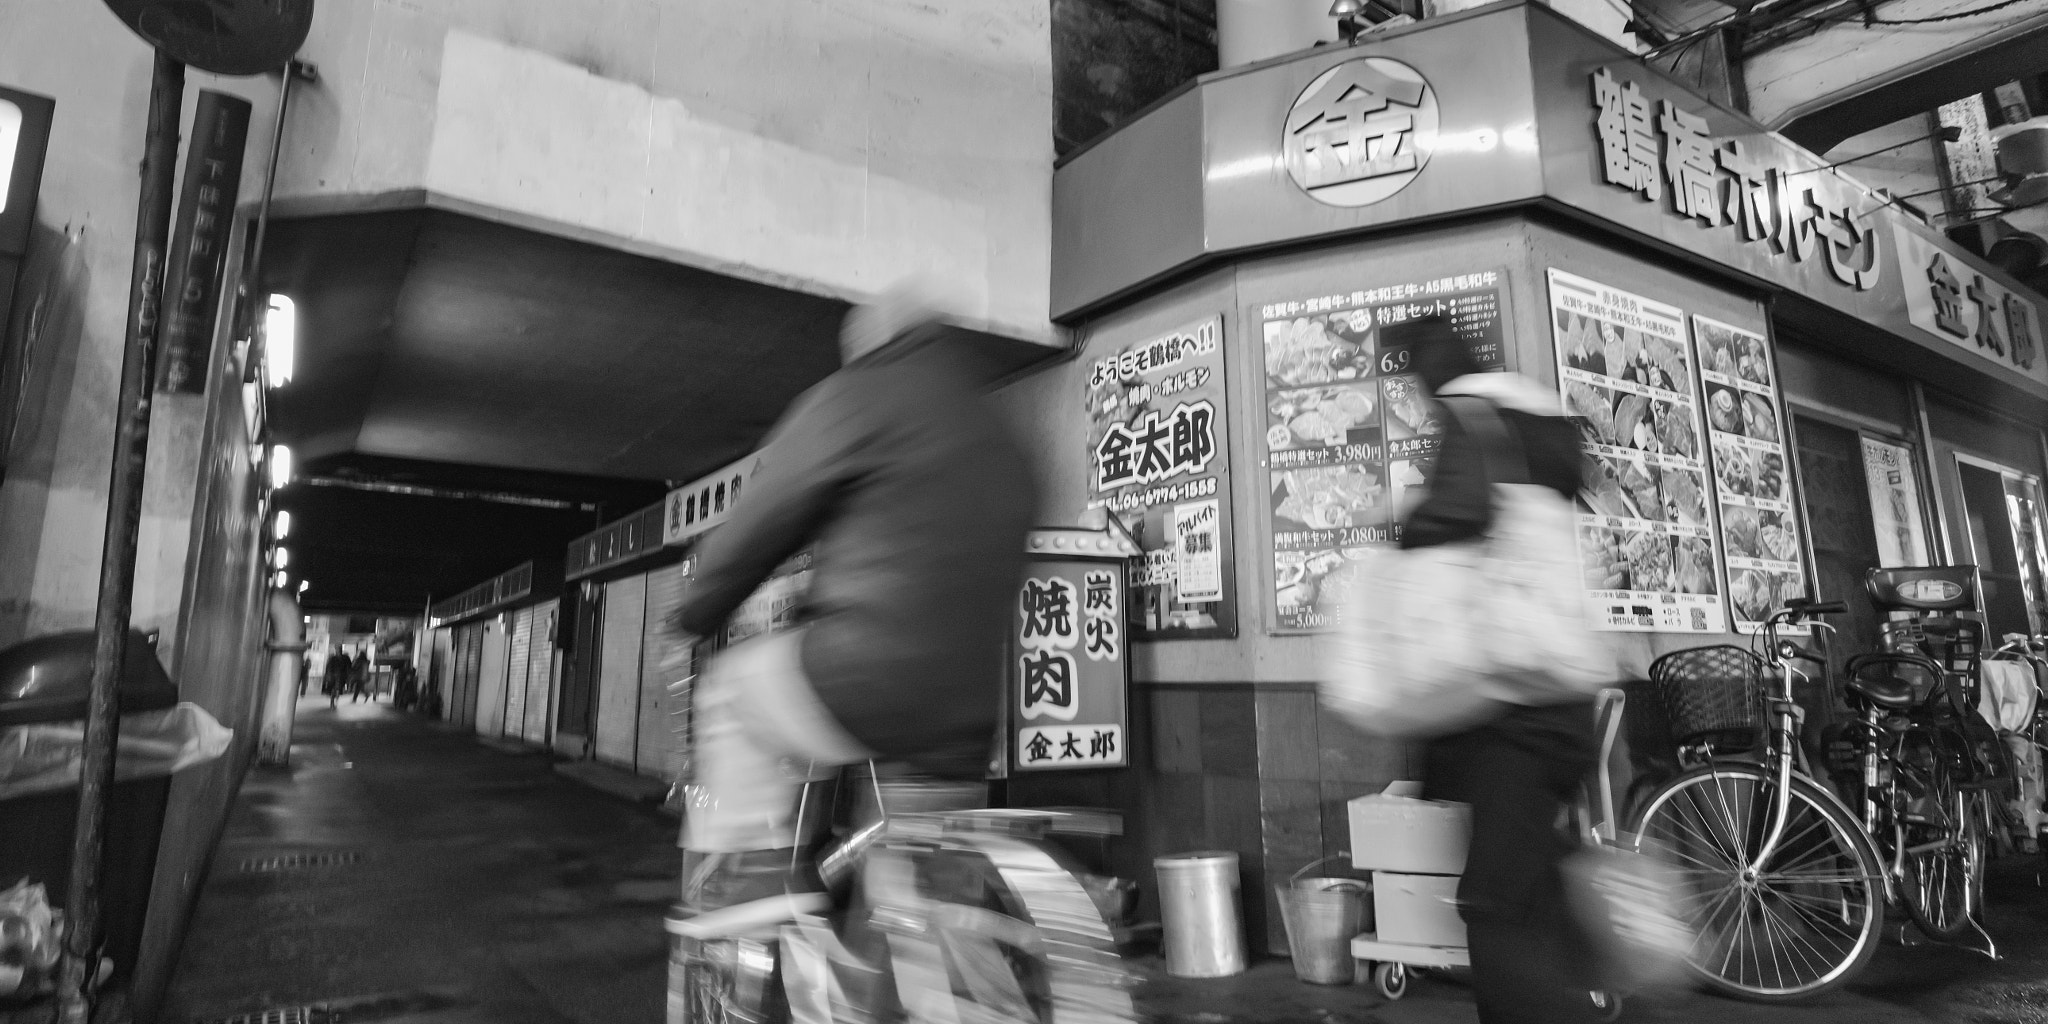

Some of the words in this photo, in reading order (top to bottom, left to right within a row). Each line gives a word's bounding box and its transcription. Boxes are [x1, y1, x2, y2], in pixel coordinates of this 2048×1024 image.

[1290, 57, 1426, 190] 金
[1590, 67, 1880, 291] 鶴橋ホルモン
[1926, 253, 2038, 369] 金太郎
[1098, 402, 1217, 490] 金太郎
[1022, 581, 1072, 708] 焼肉
[1086, 574, 1113, 654] 炭火
[1025, 731, 1115, 763] 金太郎
